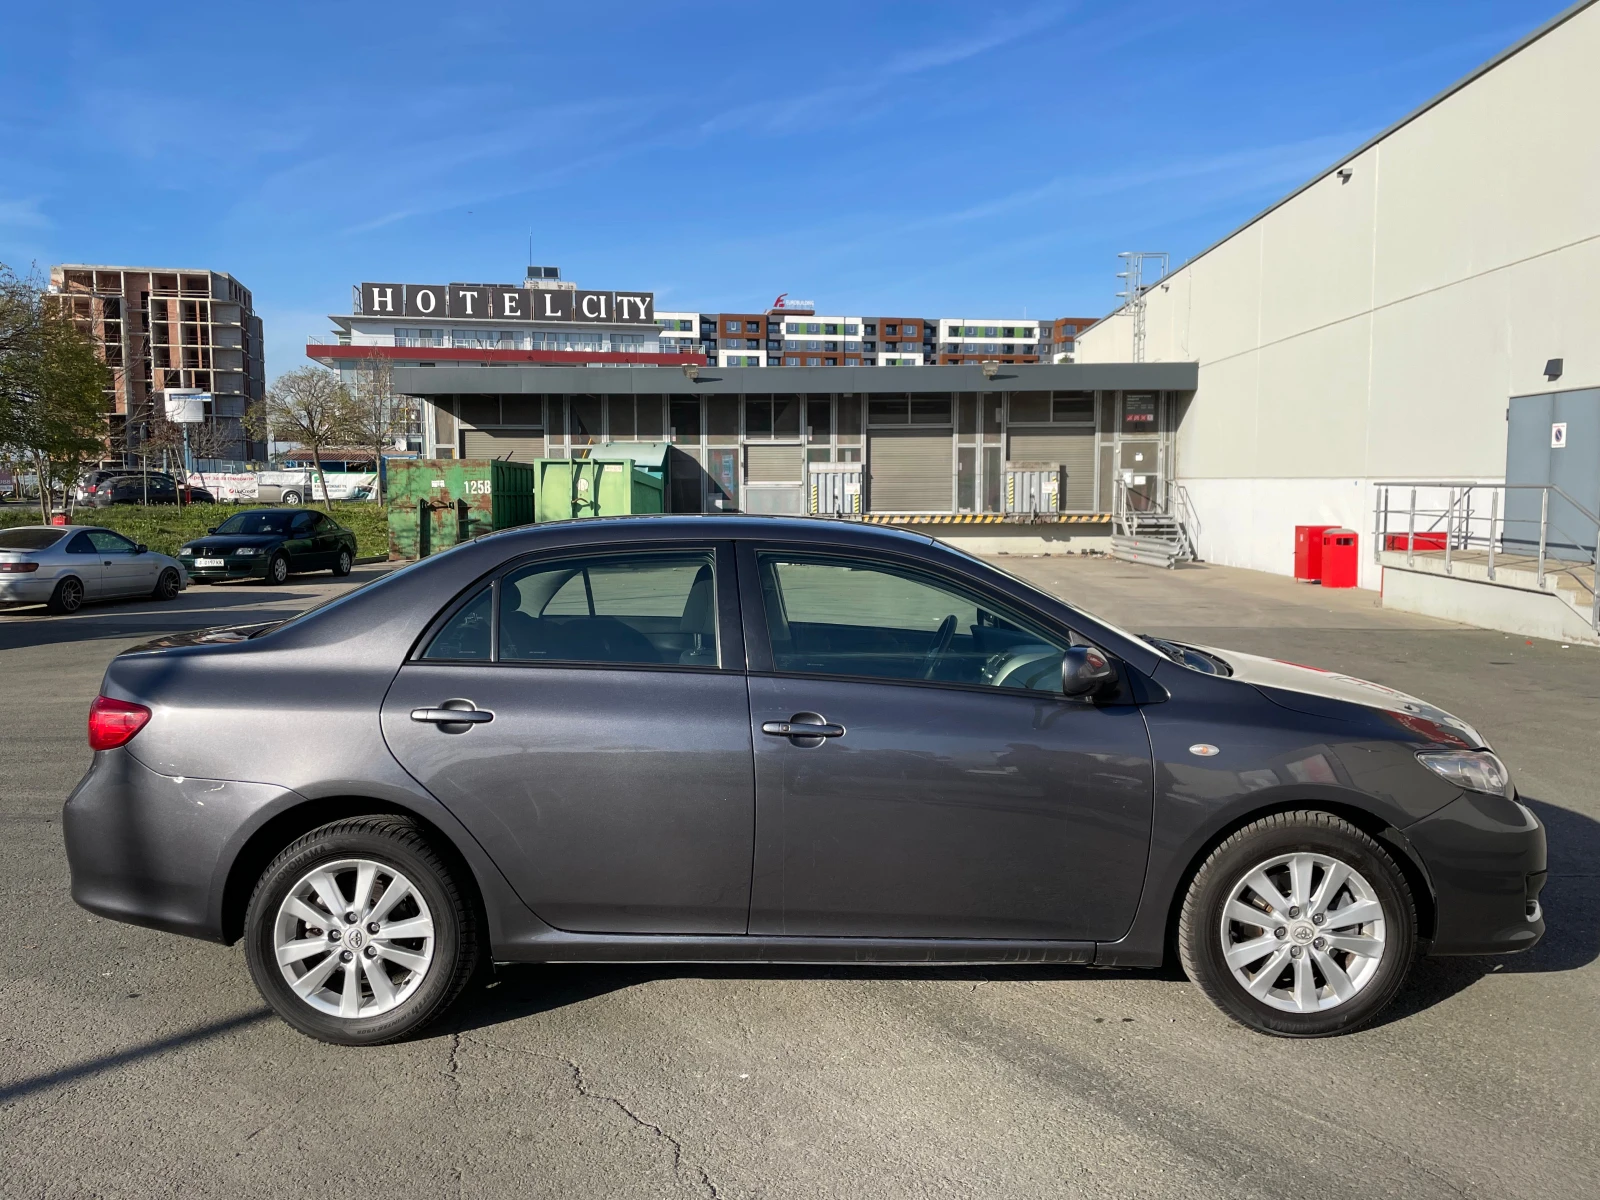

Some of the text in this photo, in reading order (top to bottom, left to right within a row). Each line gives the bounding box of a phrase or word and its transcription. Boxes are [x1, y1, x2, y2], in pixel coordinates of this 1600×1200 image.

[372, 287, 651, 320] HOTEL CITY
[273, 845, 327, 885] YOKOHAMA
[377, 1014, 407, 1031] WINTER
